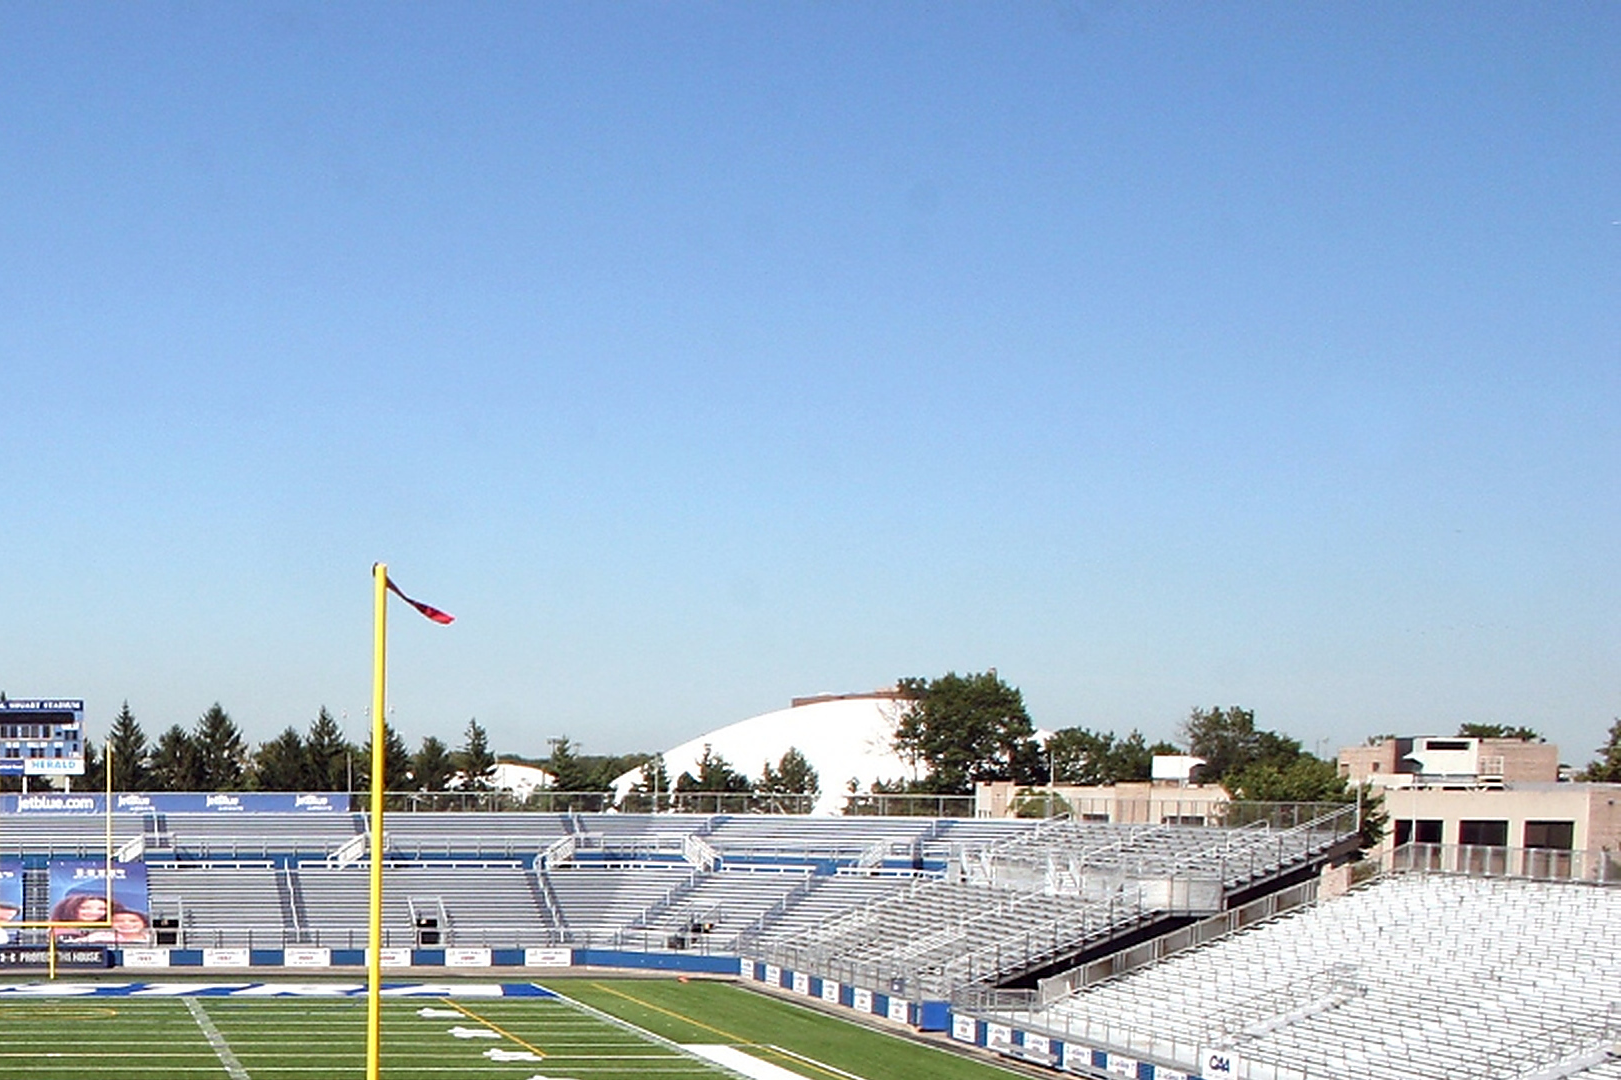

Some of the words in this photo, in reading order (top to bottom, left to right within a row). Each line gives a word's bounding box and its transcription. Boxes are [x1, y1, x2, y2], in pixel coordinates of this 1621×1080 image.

[31, 761, 76, 769] HERALD
[17, 795, 94, 812] jetblue.com
[20, 952, 55, 963] PROTEC
